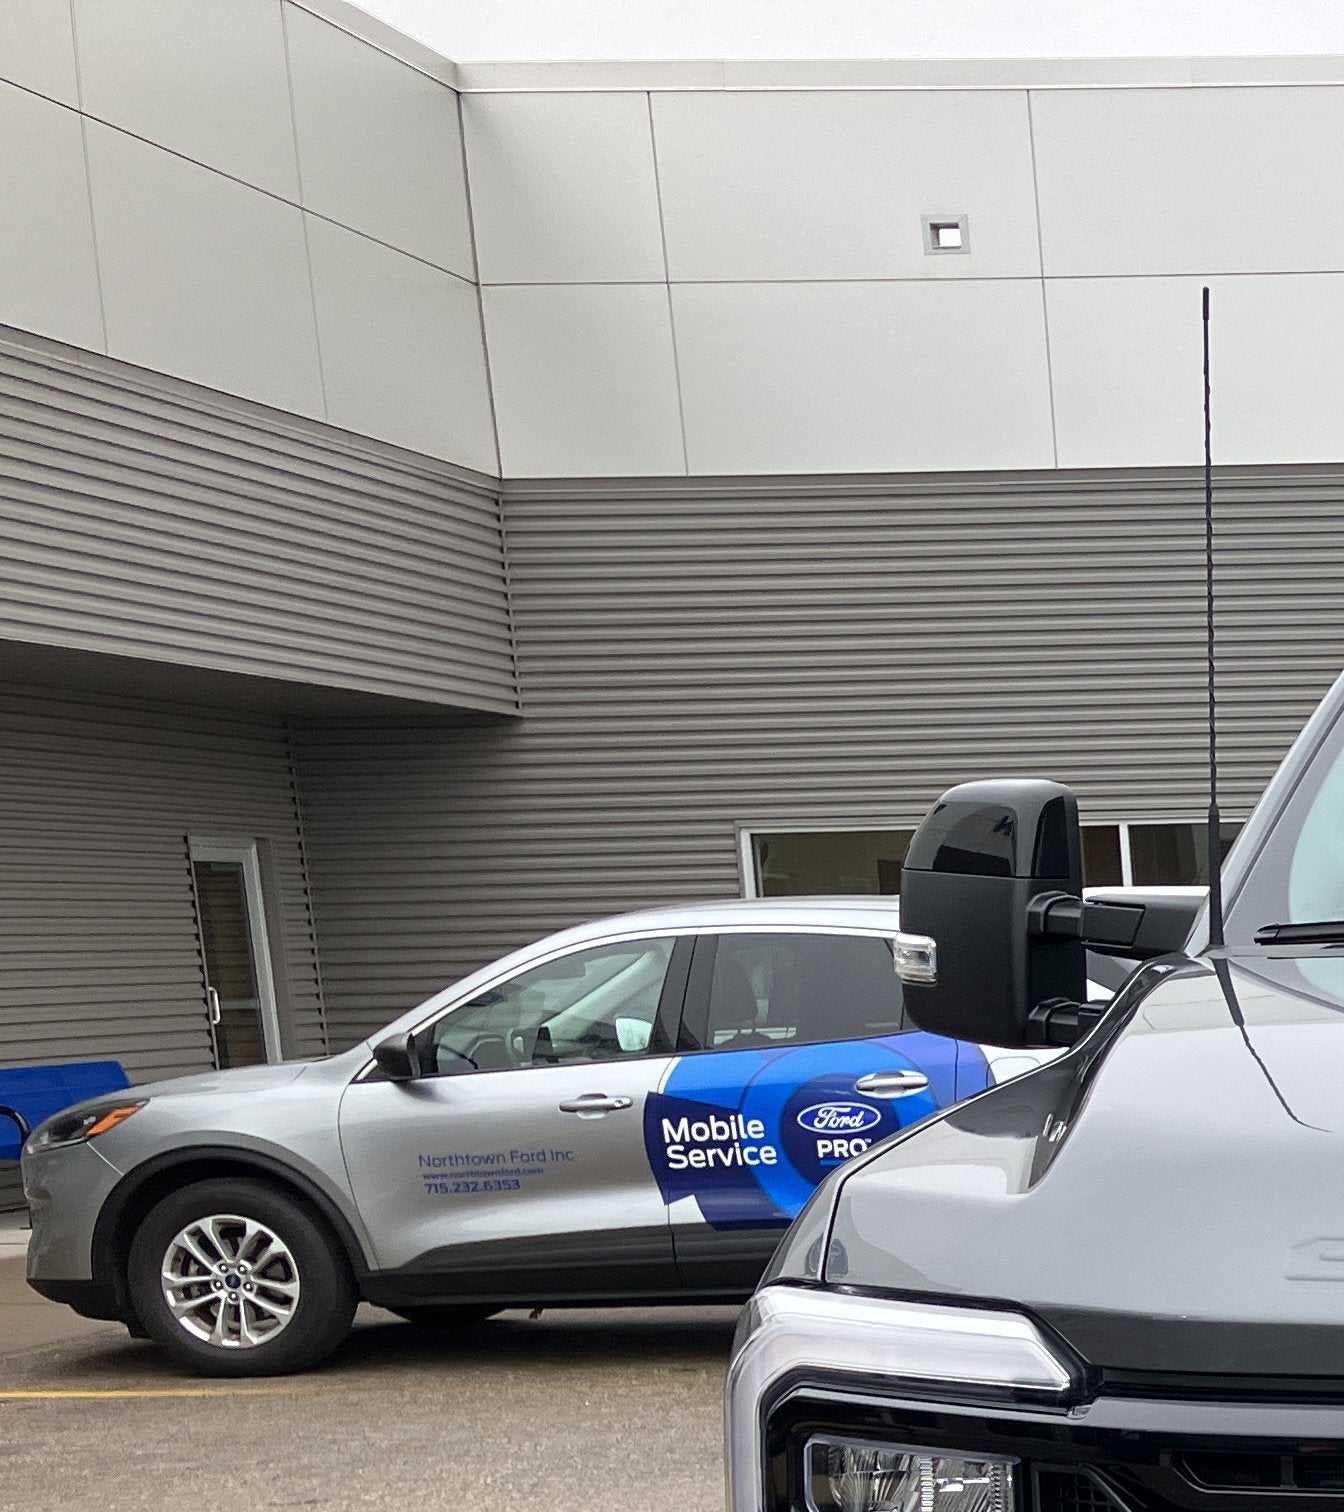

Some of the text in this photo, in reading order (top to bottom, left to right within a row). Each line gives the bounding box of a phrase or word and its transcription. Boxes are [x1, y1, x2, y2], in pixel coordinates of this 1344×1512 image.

[662, 1114, 765, 1144] Mobile
[814, 1107, 865, 1129] Ford
[418, 1149, 574, 1169] Northtown Ford Inc
[666, 1144, 778, 1170] Service
[424, 1178, 521, 1195] 715.232.6353
